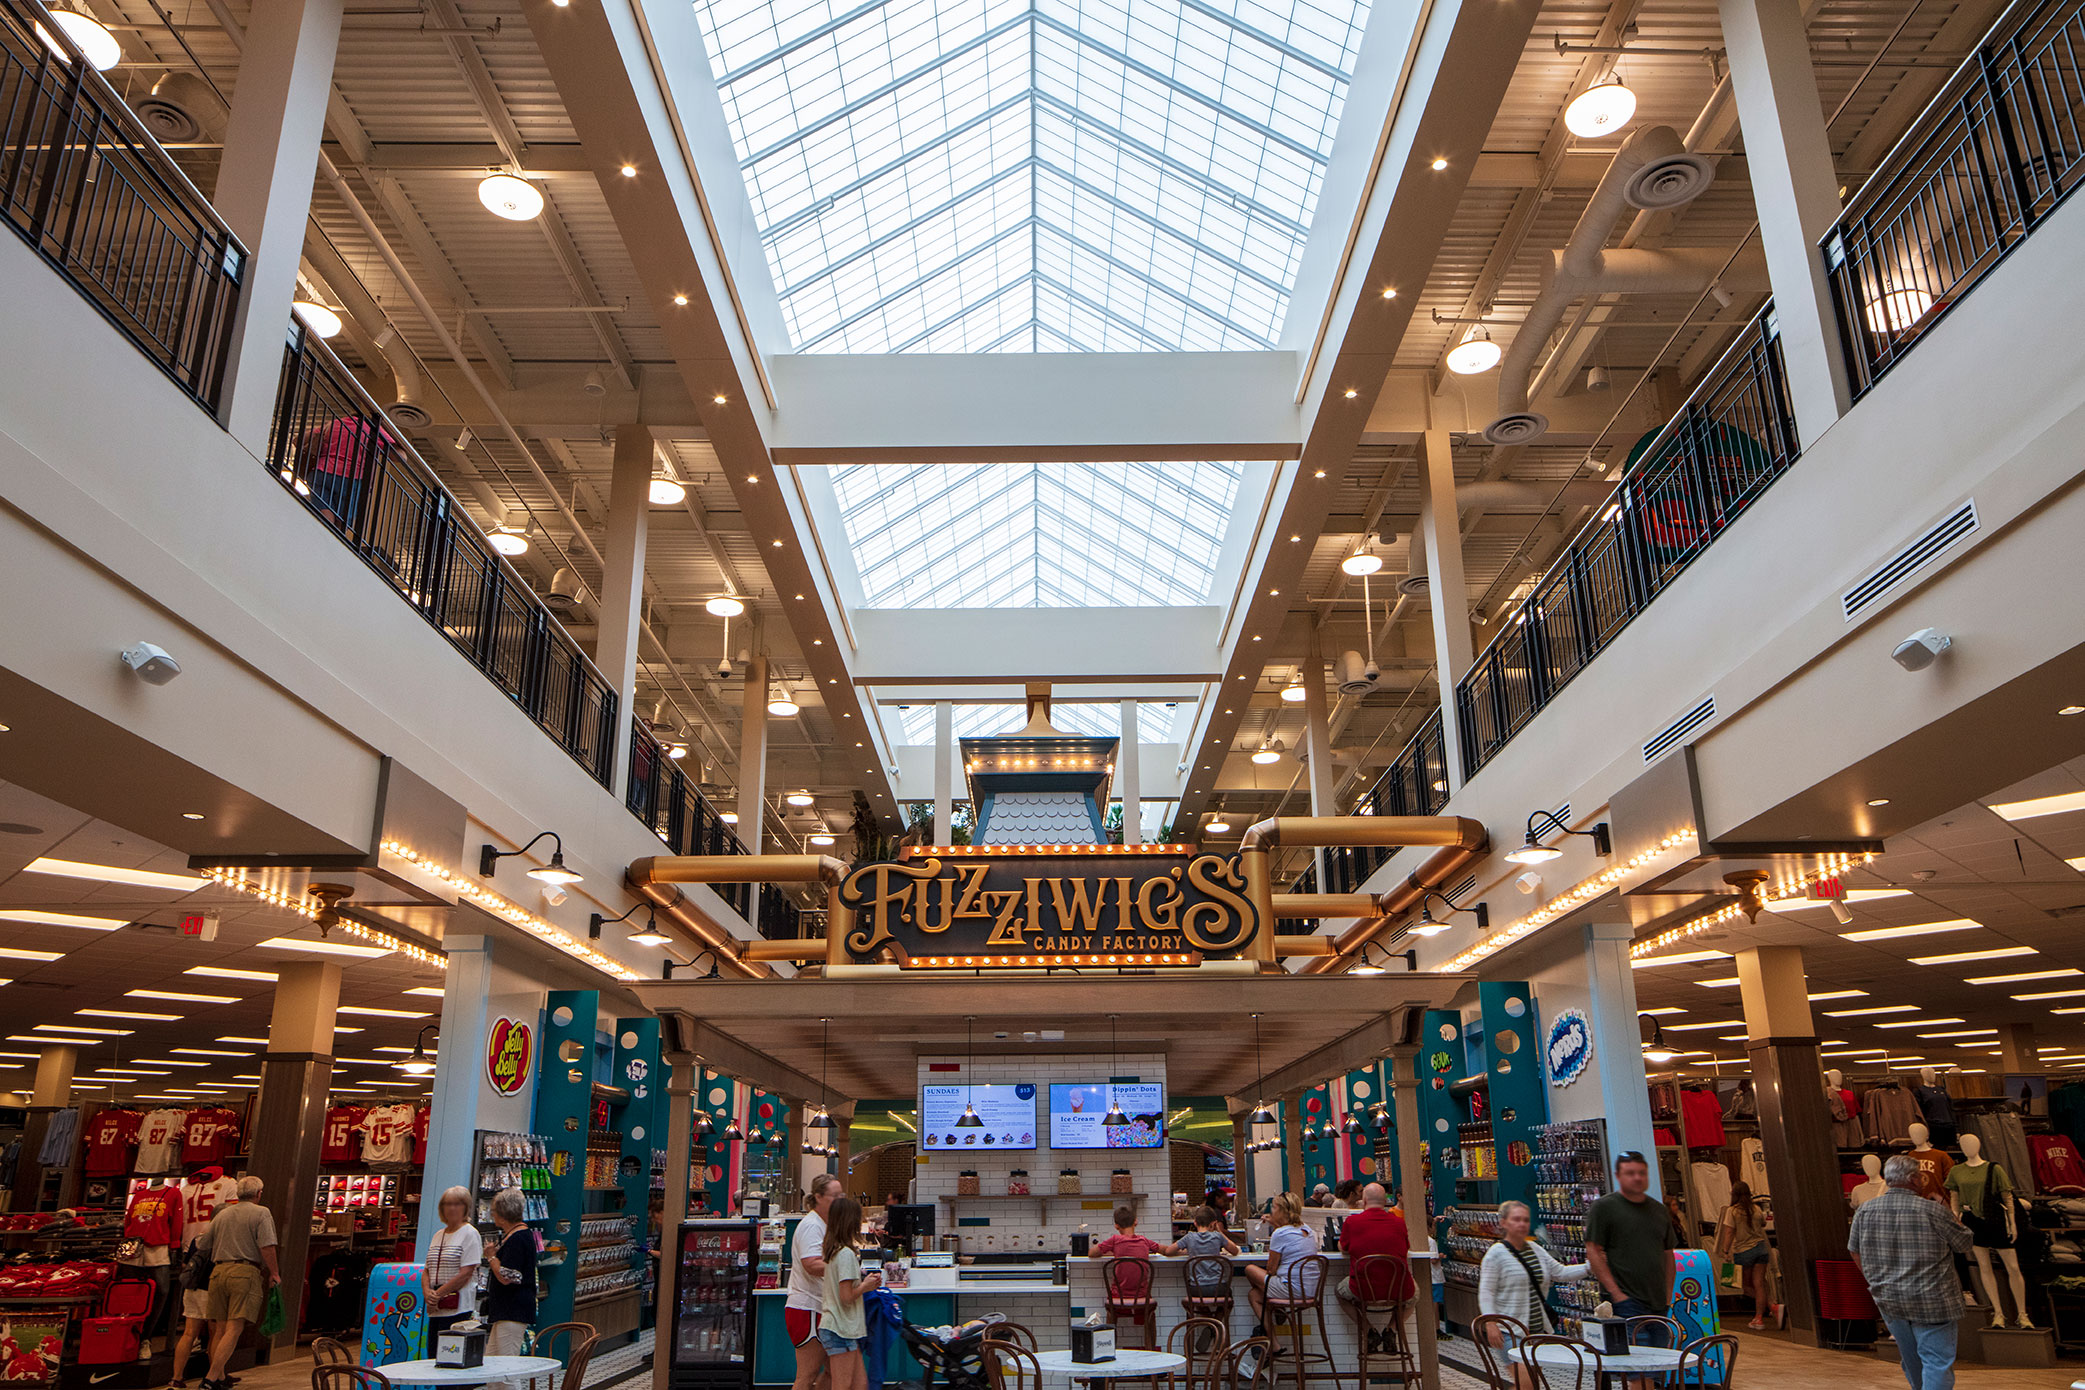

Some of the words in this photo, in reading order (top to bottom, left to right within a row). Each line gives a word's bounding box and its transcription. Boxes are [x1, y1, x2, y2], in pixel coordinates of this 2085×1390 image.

[1815, 878, 1840, 897] EXIT
[842, 855, 1257, 953] FUZZIWIG'S
[184, 916, 204, 935] EXI
[1033, 935, 1092, 951] CANDY
[1102, 935, 1183, 951] FACTORY
[504, 1022, 524, 1059] Jelly
[495, 1050, 518, 1090] Belly
[100, 1128, 119, 1145] 87
[149, 1128, 167, 1145] 87
[189, 1123, 217, 1147] 87
[328, 1123, 350, 1147] 15
[371, 1123, 393, 1146] 15
[187, 1193, 215, 1224] 15
